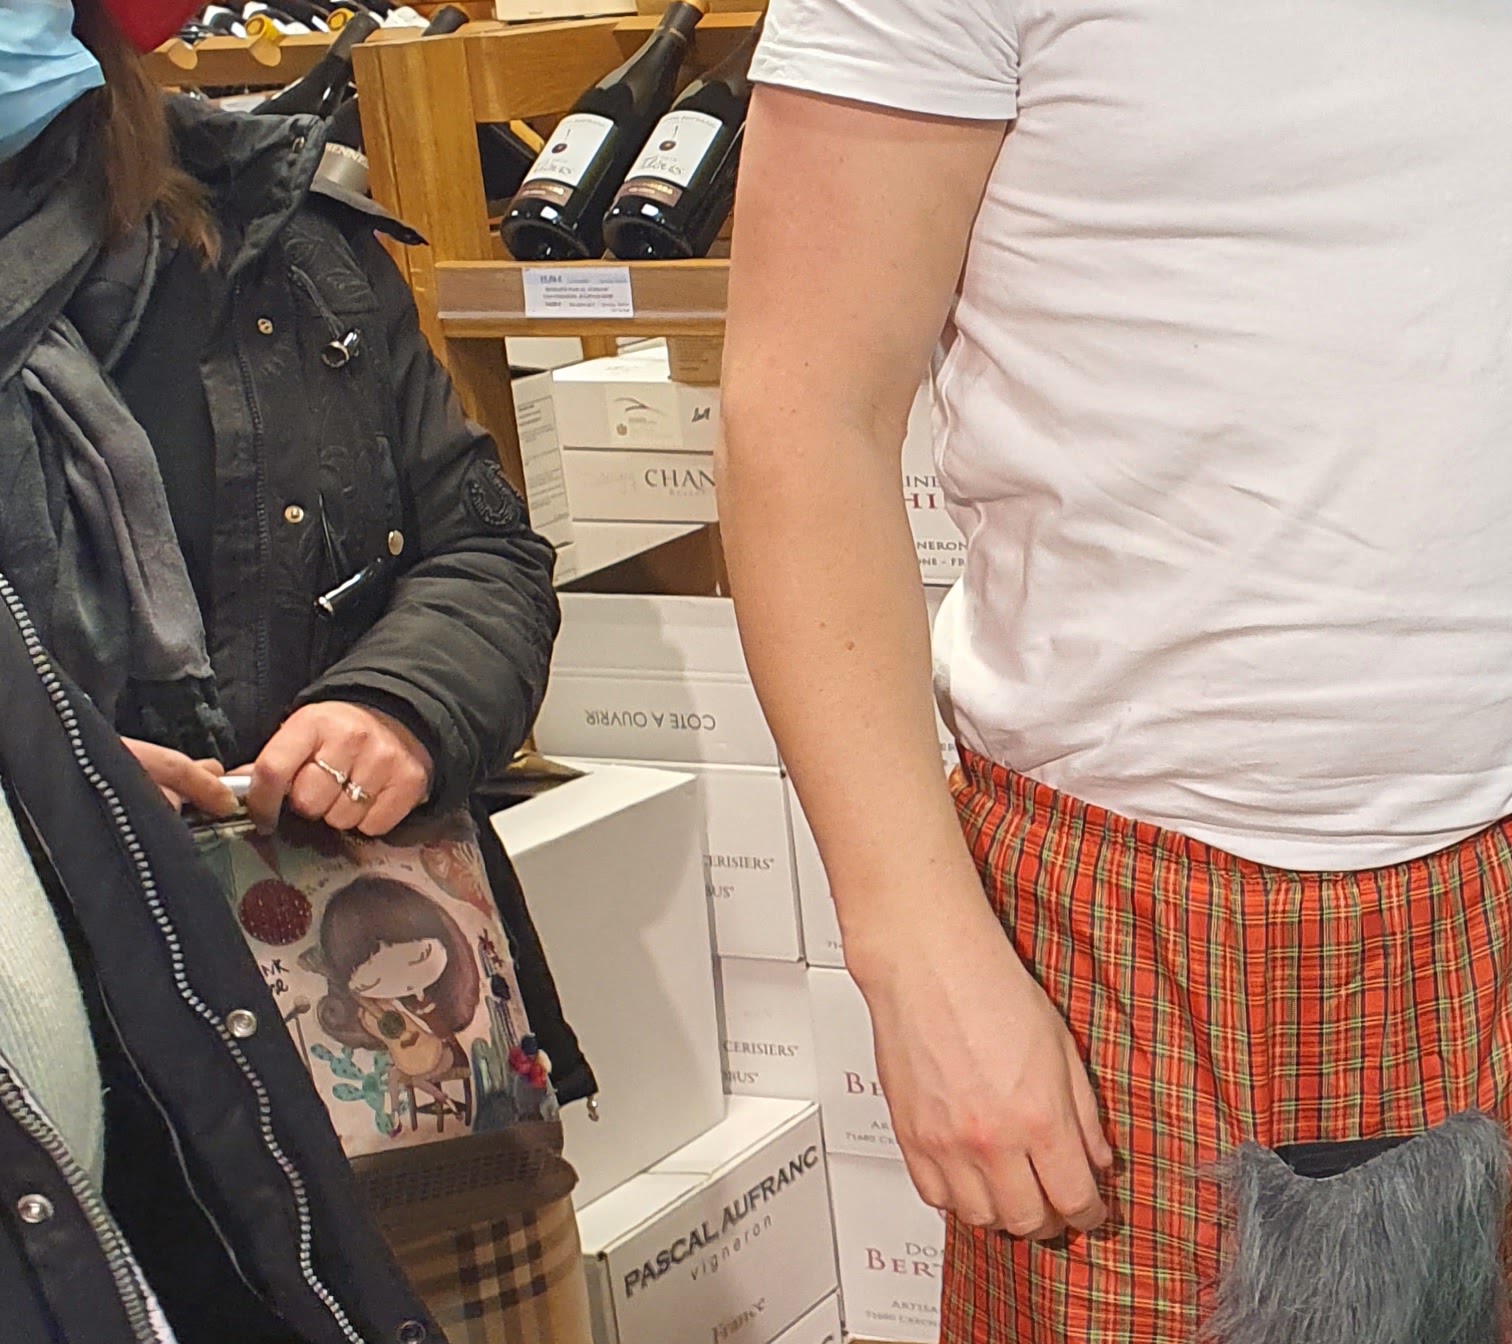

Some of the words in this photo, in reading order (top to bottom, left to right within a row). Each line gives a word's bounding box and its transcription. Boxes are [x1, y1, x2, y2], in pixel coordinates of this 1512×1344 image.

[585, 709, 648, 728] OUVRIR
[653, 712, 665, 728] A
[671, 712, 716, 731] COTE
[623, 1219, 720, 1298] PASCAL
[721, 1144, 818, 1234] AUFRANC
[689, 1213, 773, 1282] vigneron
[904, 1242, 944, 1257] DO
